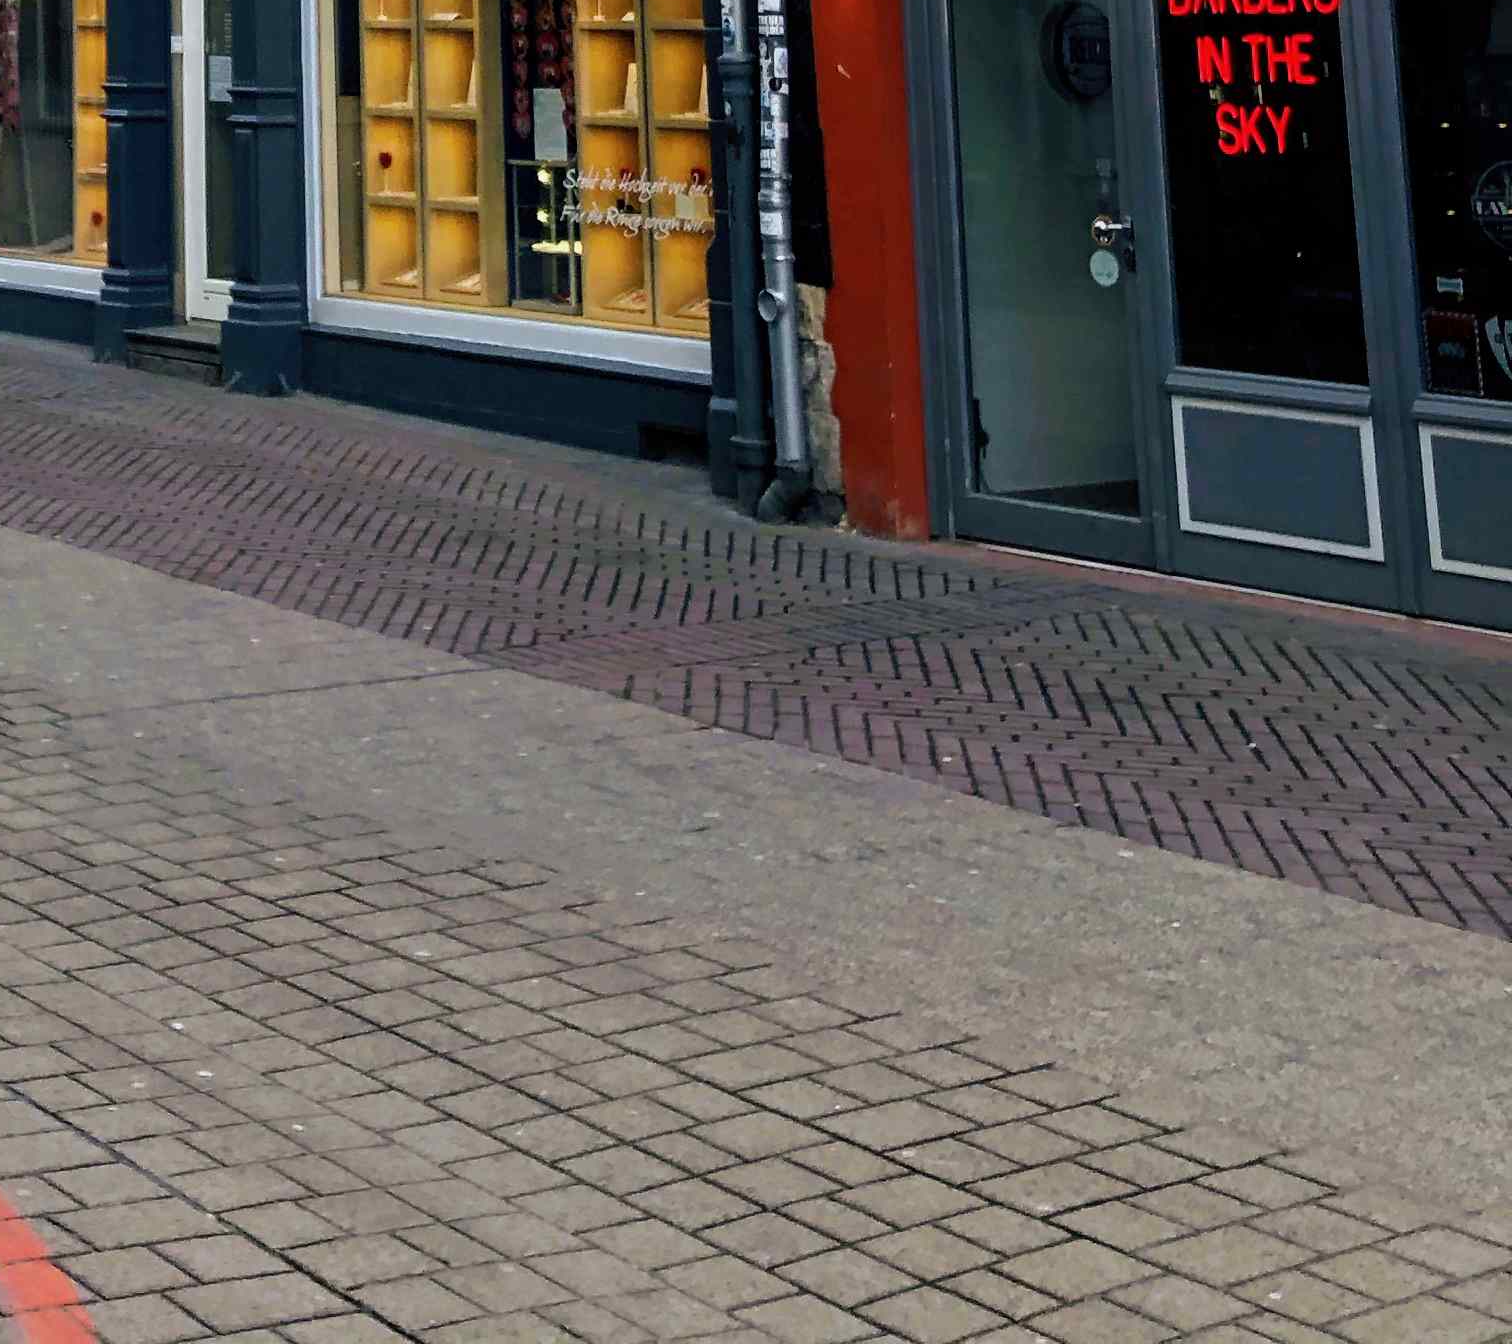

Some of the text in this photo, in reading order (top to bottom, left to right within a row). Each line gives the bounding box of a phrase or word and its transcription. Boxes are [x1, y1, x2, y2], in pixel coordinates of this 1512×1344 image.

[1196, 33, 1317, 84] IN THE
[1216, 102, 1292, 155] SKY
[605, 206, 642, 238] Ringe
